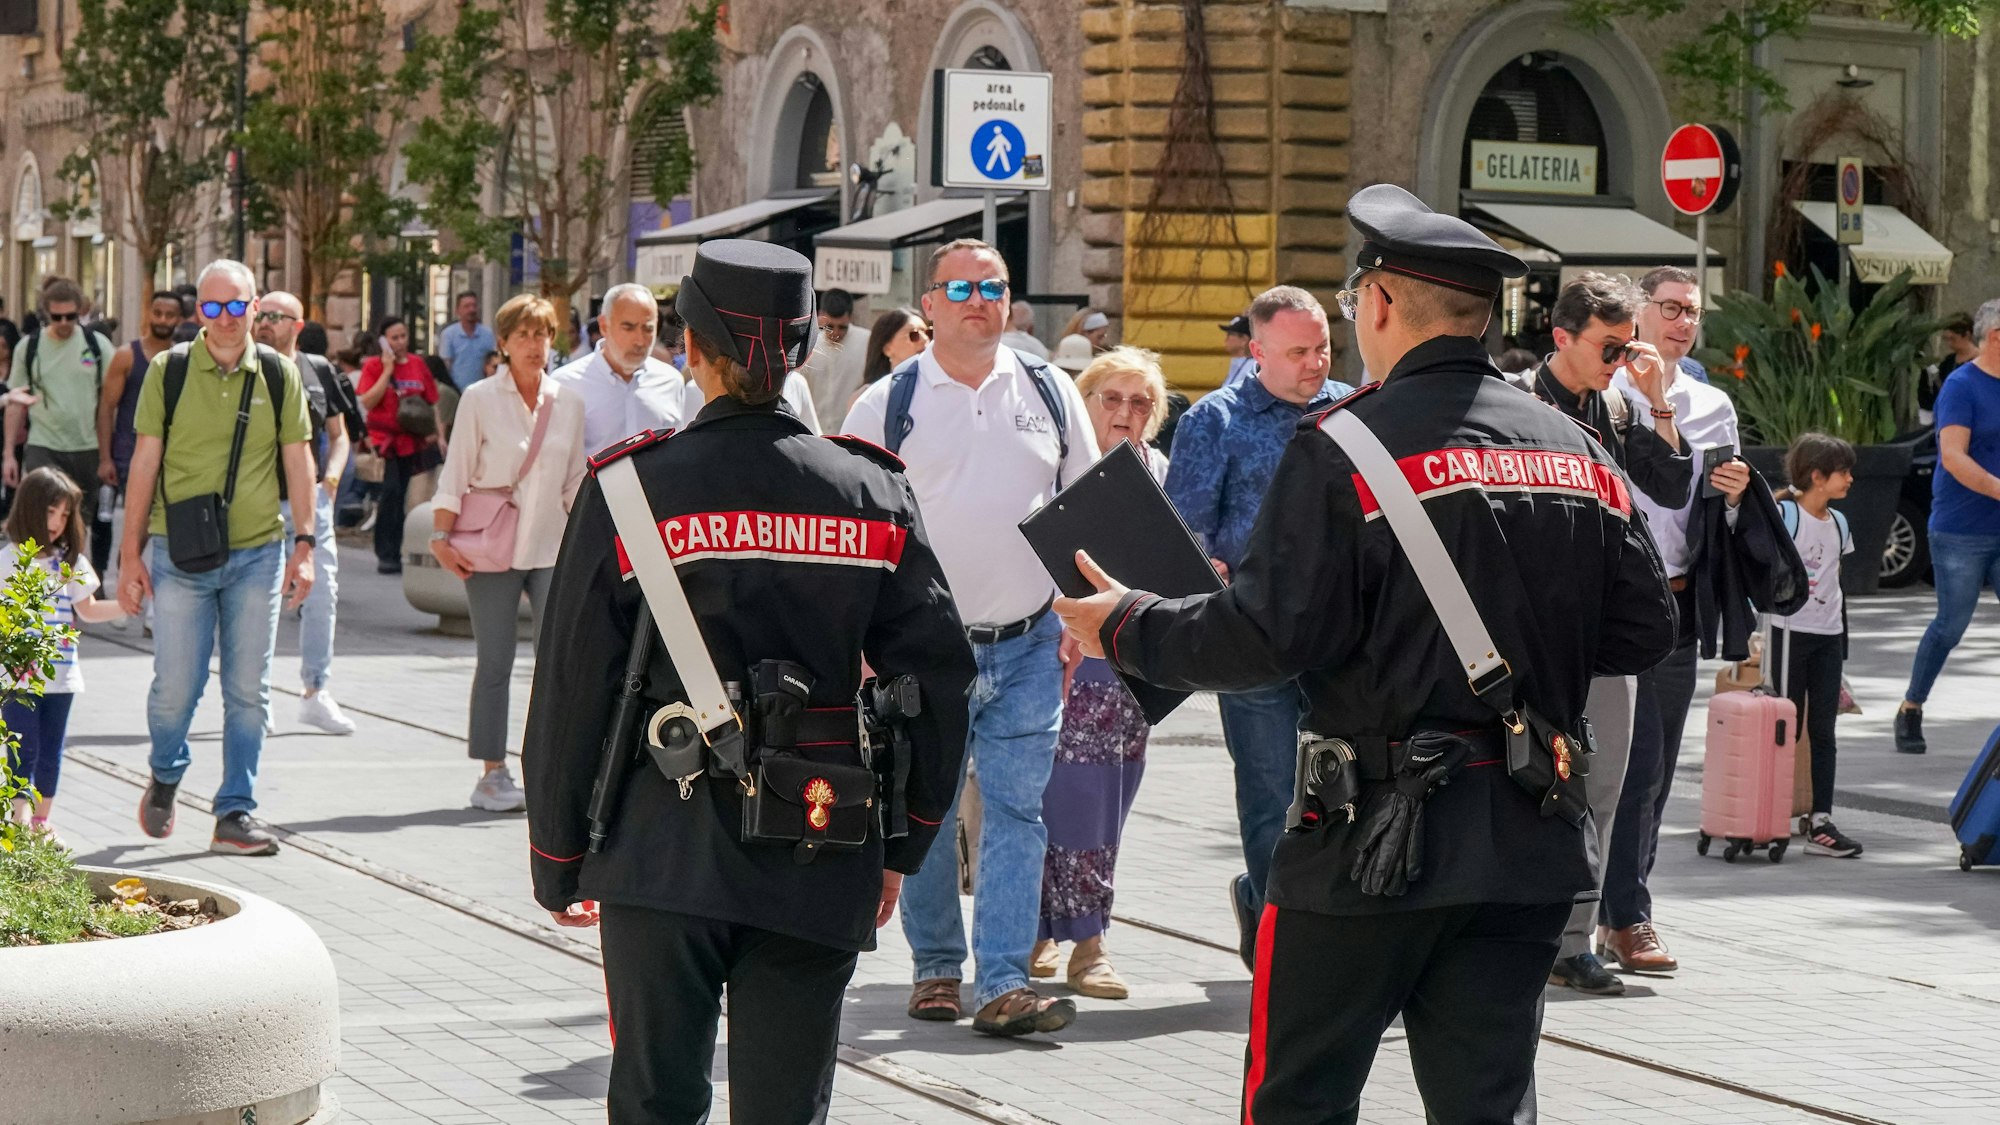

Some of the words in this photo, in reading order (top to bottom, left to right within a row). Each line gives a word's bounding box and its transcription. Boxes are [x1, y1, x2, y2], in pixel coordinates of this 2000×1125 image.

[986, 83, 1012, 94] area
[972, 98, 1026, 112] pedonale
[1486, 153, 1581, 182] GELATERIA
[1423, 451, 1596, 490] CARABINIERI
[664, 513, 868, 556] CARABINIERI
